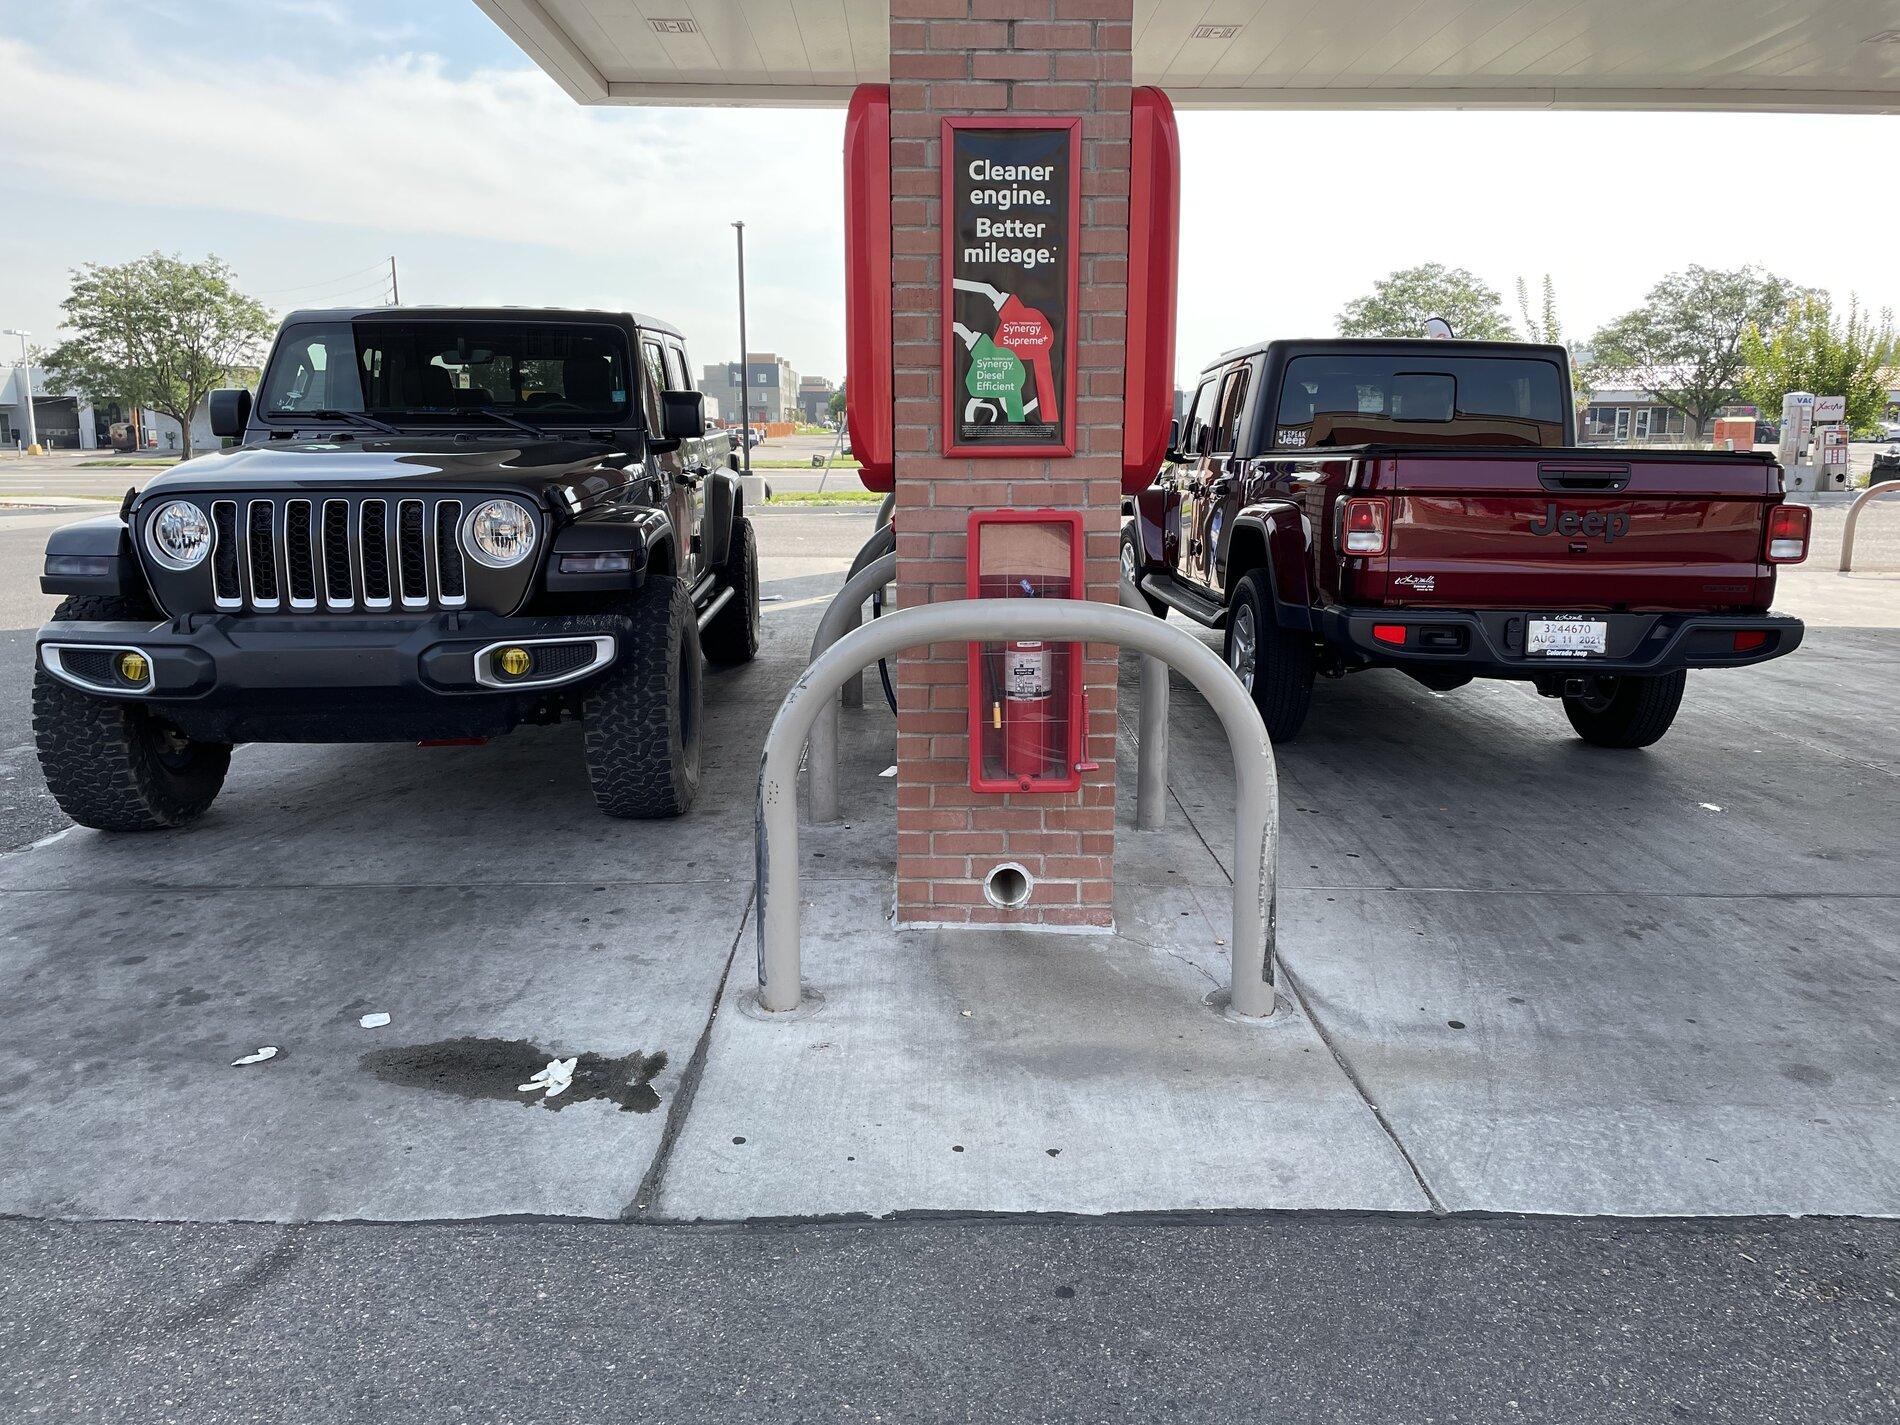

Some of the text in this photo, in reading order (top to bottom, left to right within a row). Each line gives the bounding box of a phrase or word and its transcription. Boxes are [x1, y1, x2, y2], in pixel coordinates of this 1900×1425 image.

[968, 159, 1054, 181] Cleaner
[970, 183, 1051, 210] engine.
[976, 218, 1046, 238] Better
[1003, 323, 1042, 335] Synergy
[976, 359, 1014, 370] Synergy
[976, 370, 1005, 380] Diesel
[976, 381, 1015, 391] Efficient
[1287, 430, 1307, 438] SPEAK
[1278, 434, 1306, 446] Jeep
[1530, 503, 1630, 543] Jeep
[1544, 624, 1591, 634] 3244670
[1533, 635, 1556, 643] AUG
[1563, 635, 1572, 643] 11
